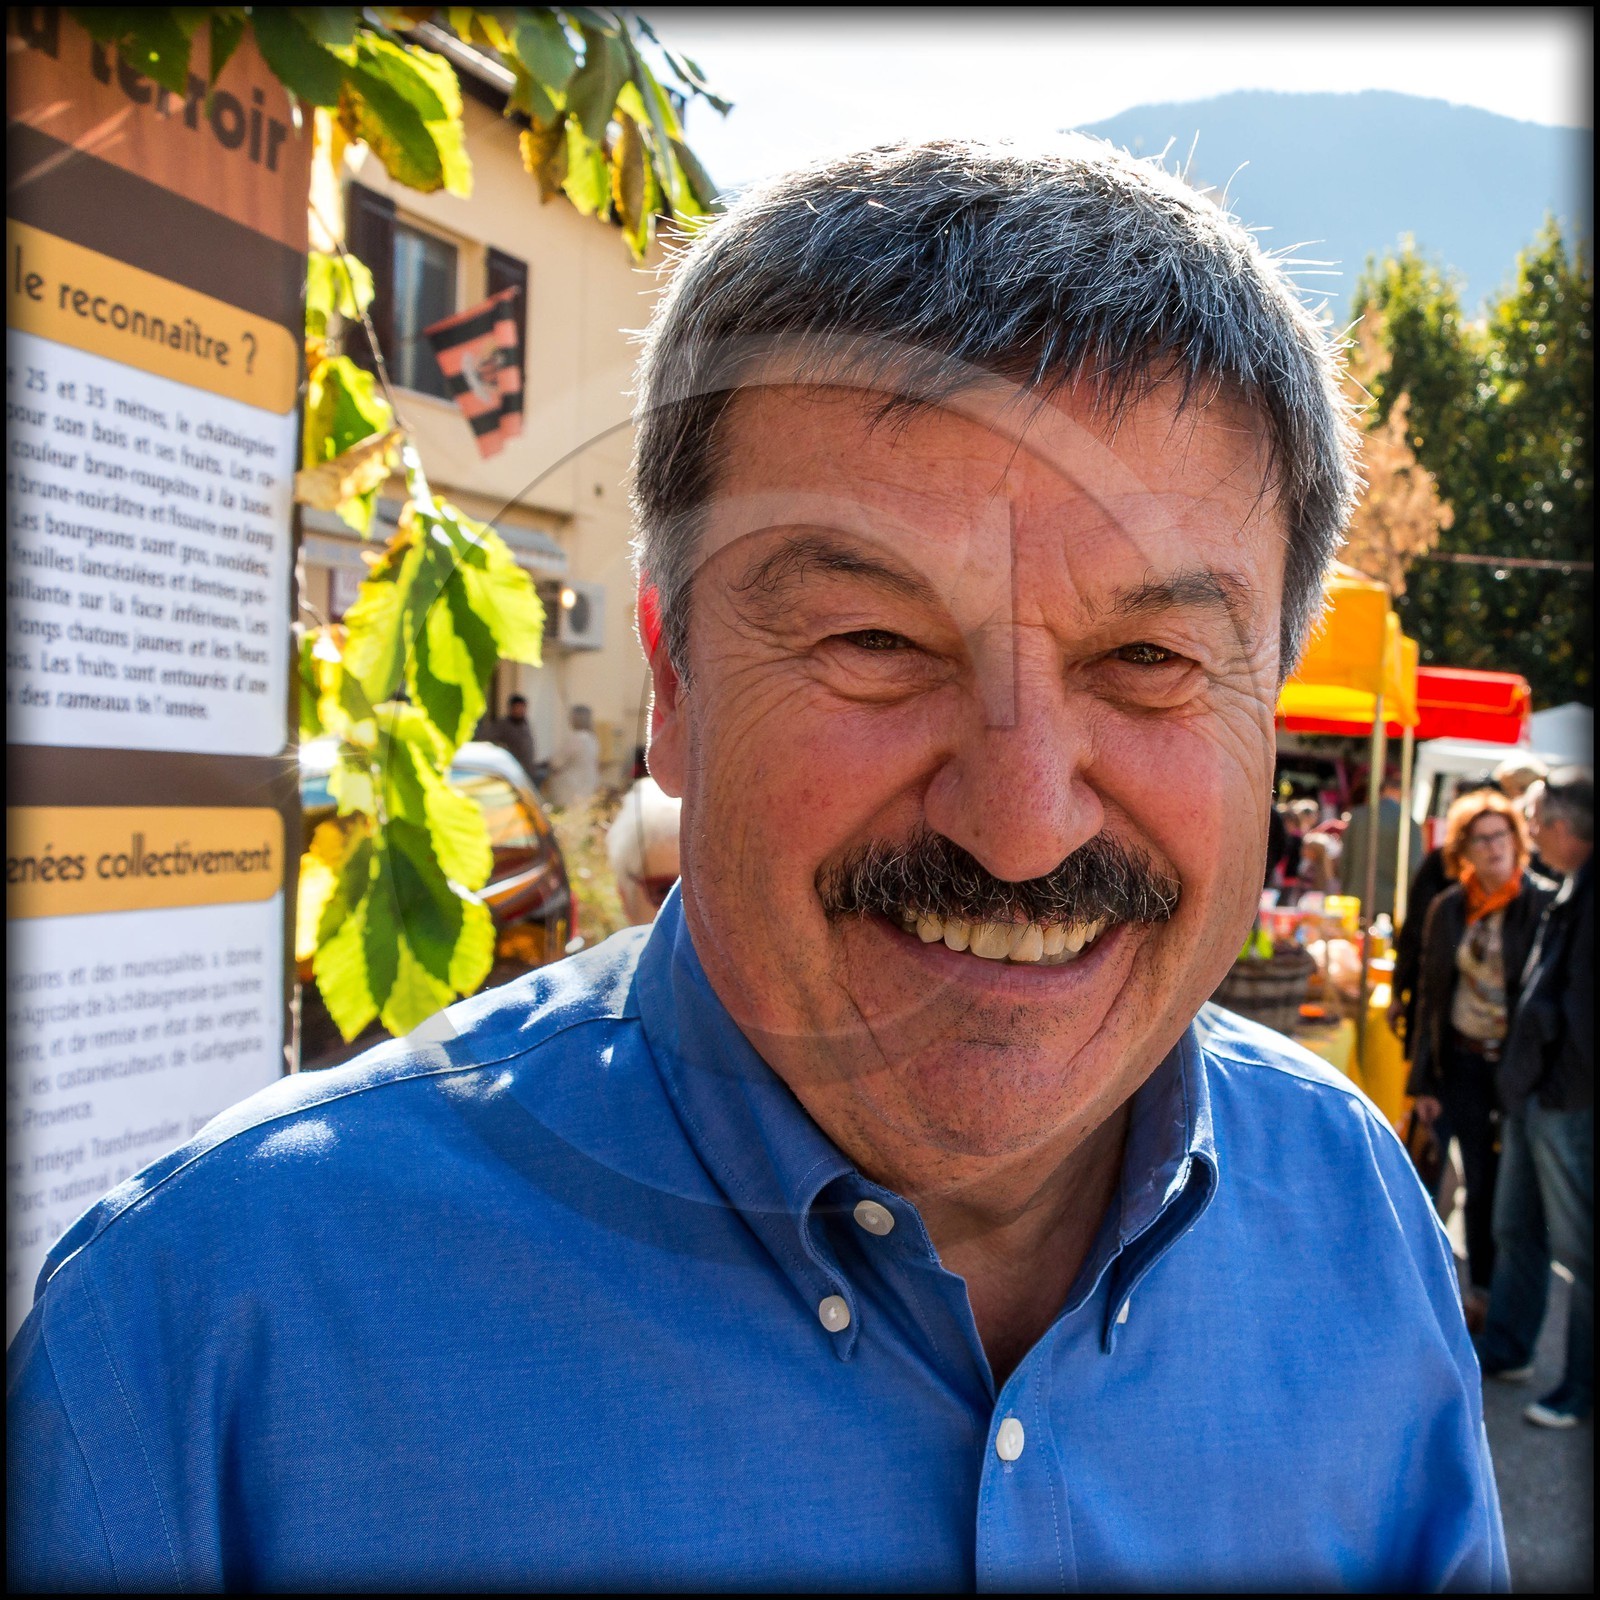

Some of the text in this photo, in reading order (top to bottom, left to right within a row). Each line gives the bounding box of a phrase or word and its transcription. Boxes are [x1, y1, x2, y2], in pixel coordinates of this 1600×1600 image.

[14, 244, 257, 376] le reconnaître ?
[26, 367, 48, 393] 25
[57, 381, 76, 401] et
[85, 384, 107, 409] 35
[53, 415, 86, 438] son
[92, 418, 128, 449] bois
[134, 435, 151, 456] et
[11, 438, 78, 469] couleur
[149, 500, 167, 522] et
[44, 512, 136, 548] bourgeons
[141, 533, 176, 559] sont
[78, 591, 103, 610] sur
[109, 591, 124, 614] la
[131, 594, 163, 620] face
[67, 619, 129, 647] chatons
[41, 650, 71, 675] Les
[77, 652, 118, 680] fruits
[19, 683, 50, 707] des
[56, 689, 131, 712] rameaux
[96, 831, 272, 880] collectivement
